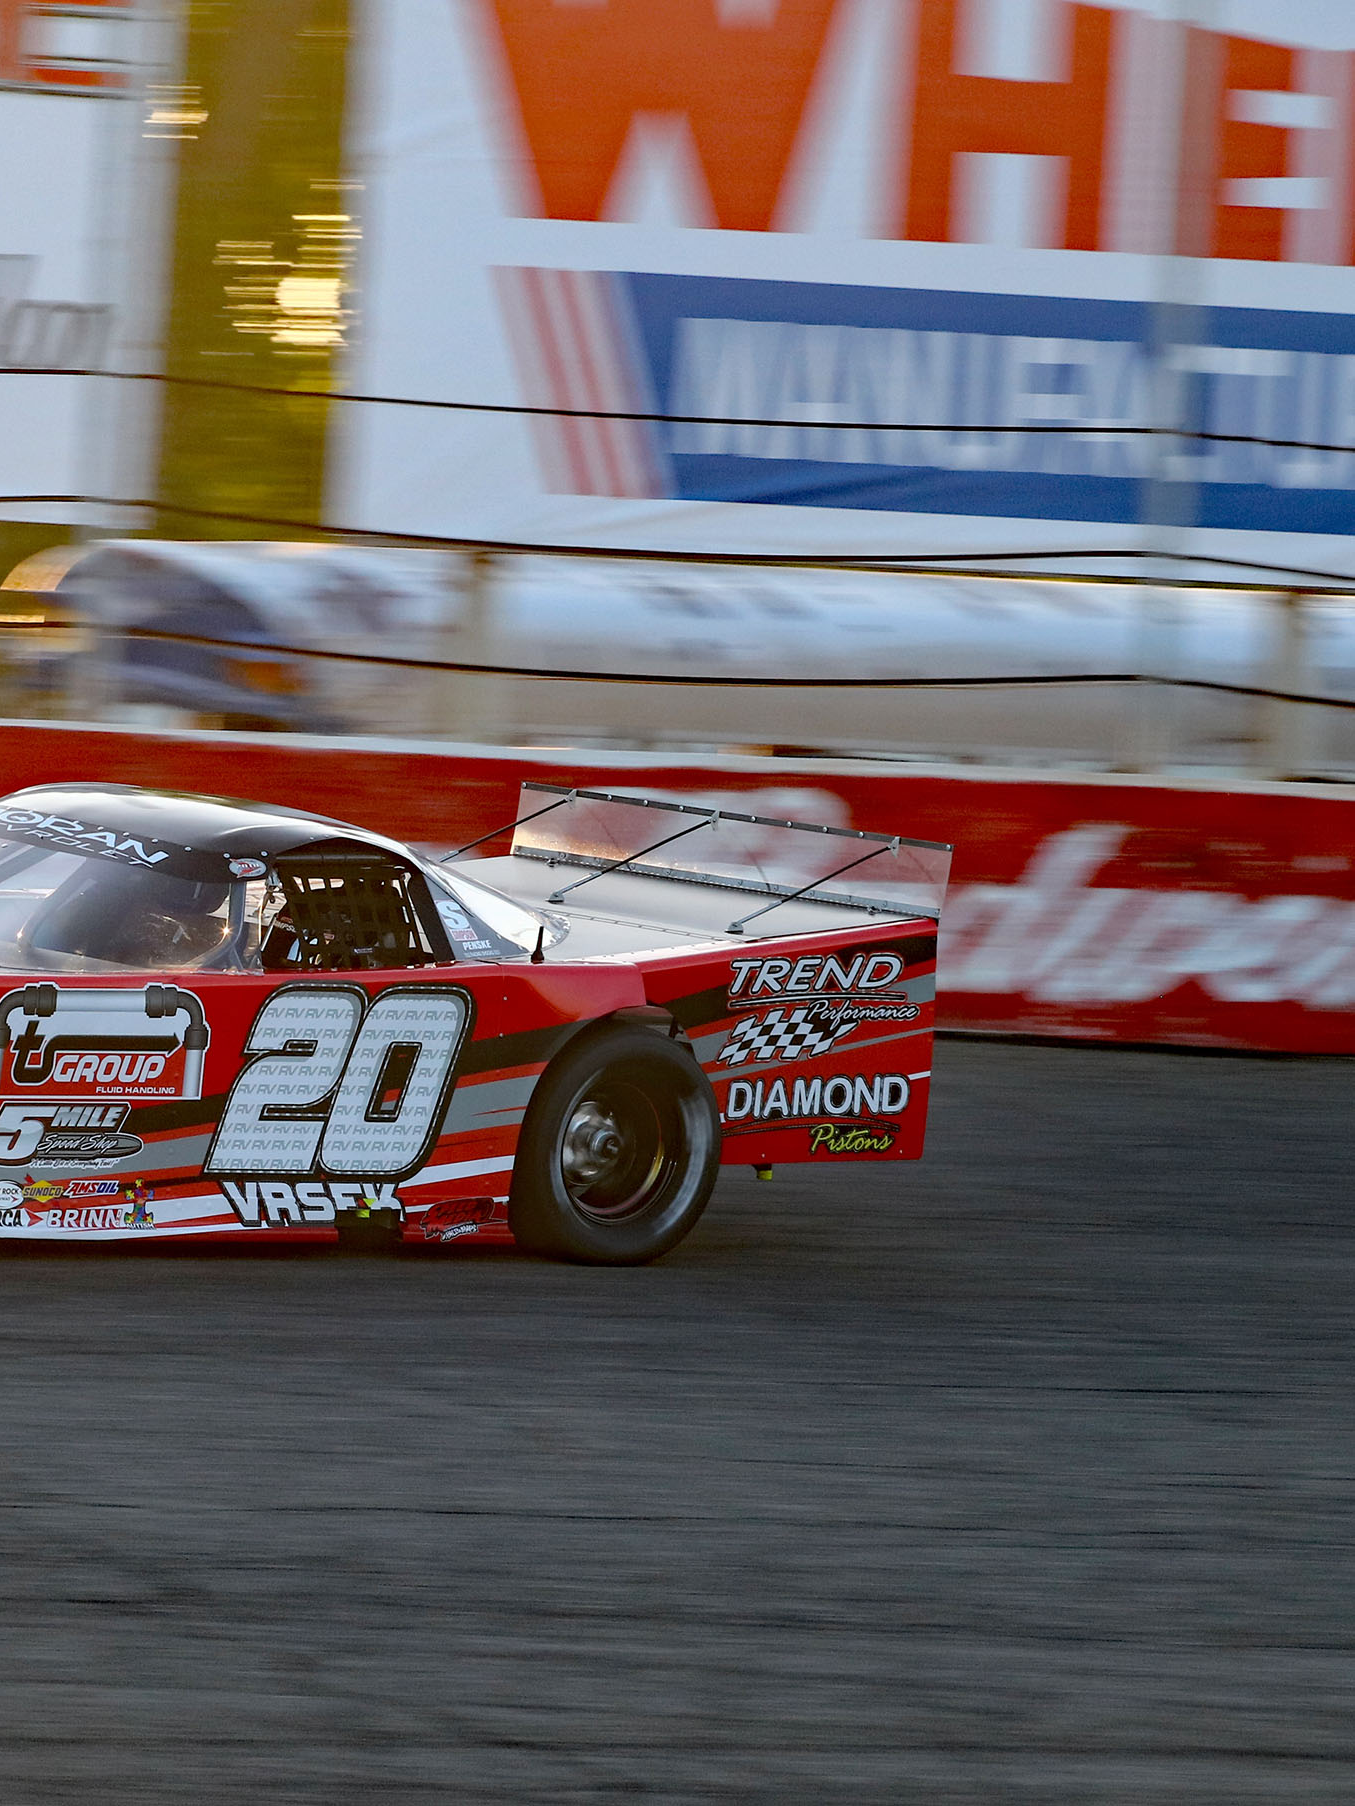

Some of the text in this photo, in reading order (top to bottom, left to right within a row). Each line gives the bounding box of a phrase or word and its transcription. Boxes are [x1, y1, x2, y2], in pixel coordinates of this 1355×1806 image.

[729, 953, 903, 995] TREND
[808, 1000, 918, 1030] Performance
[52, 1054, 166, 1083] GROUP
[203, 981, 475, 1176] 20
[96, 1086, 176, 1095] FLUID HANDLING
[727, 1075, 909, 1118] DIAMOND
[51, 1106, 124, 1128] MILE
[37, 1133, 119, 1154] Speed Shop
[810, 1124, 893, 1154] Pistons
[2, 1187, 20, 1195] ROCK
[22, 1186, 62, 1198] SUNOCO
[64, 1181, 119, 1198] AMSOIL
[47, 1208, 122, 1229] BRINN
